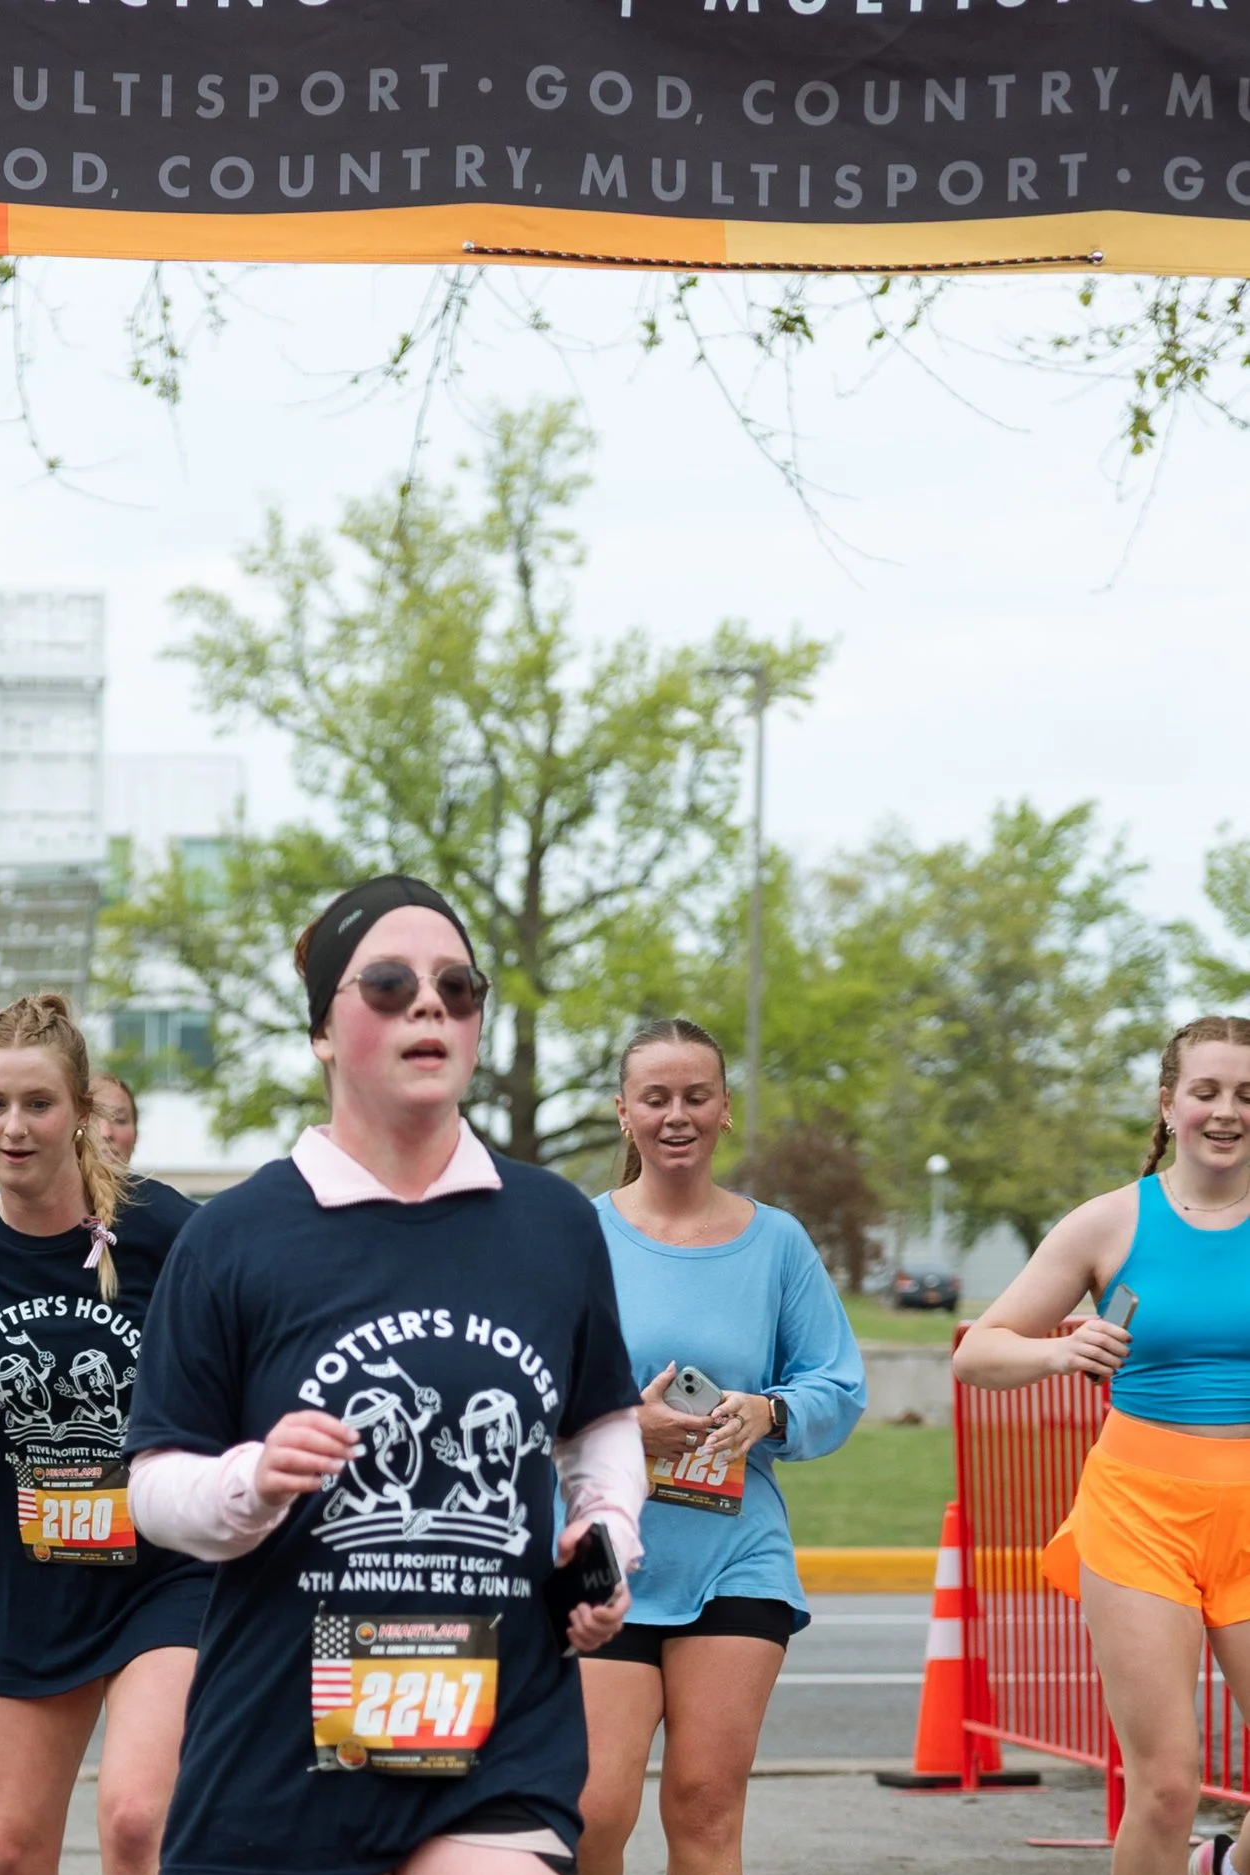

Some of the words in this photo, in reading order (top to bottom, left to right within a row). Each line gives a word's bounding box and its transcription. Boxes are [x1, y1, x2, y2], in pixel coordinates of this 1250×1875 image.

[526, 64, 703, 125] GOD,
[742, 67, 1128, 126] COUNTRY,
[158, 144, 542, 200] COUNTRY,
[579, 152, 1088, 209] MULTISPORT
[298, 1308, 454, 1408] POTTER'S
[465, 1313, 559, 1413] HOUSE
[26, 1444, 51, 1455] STEVE
[92, 1448, 123, 1459] LEGAC
[42, 1497, 114, 1541] 2120
[298, 1571, 334, 1592] 4TH
[339, 1571, 425, 1592] ANNUAL
[430, 1572, 457, 1594] 5K
[461, 1576, 476, 1596] &
[348, 1553, 390, 1568] STEVE
[394, 1553, 458, 1570] PROFFITT
[352, 1672, 483, 1737] 2247
